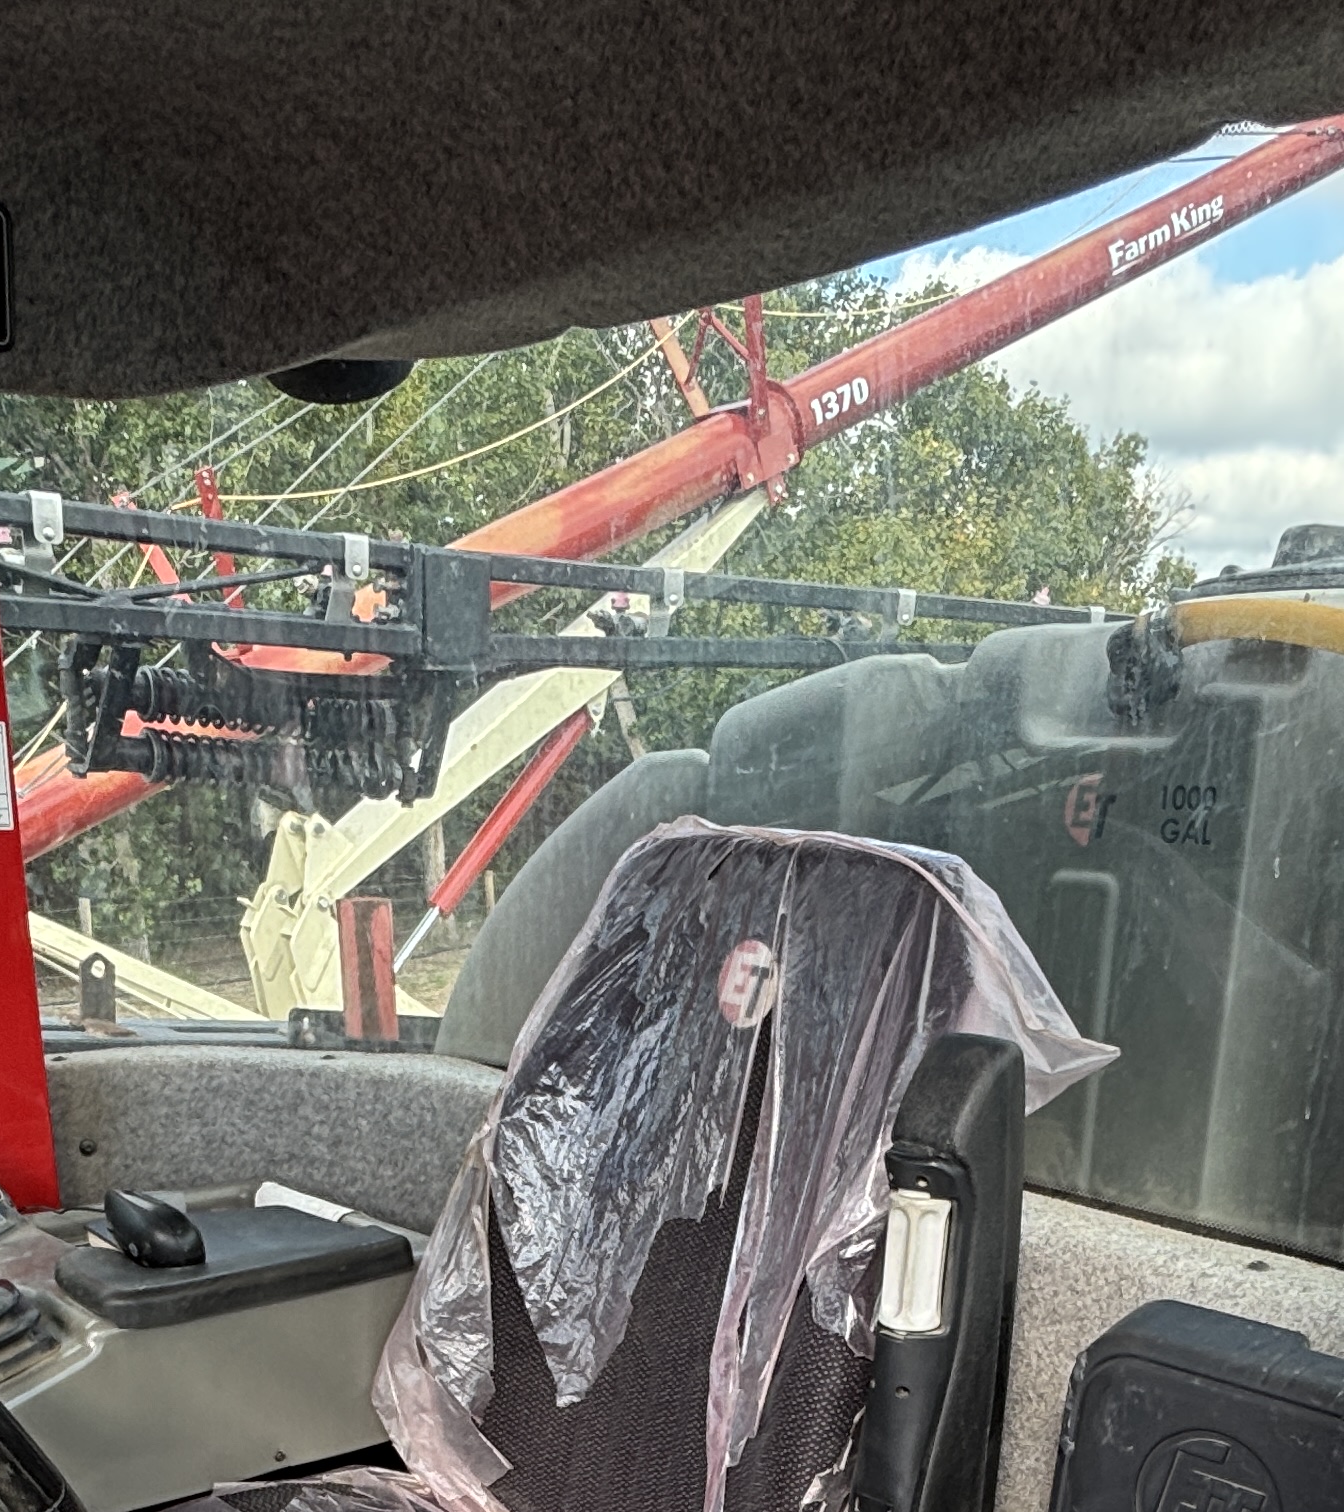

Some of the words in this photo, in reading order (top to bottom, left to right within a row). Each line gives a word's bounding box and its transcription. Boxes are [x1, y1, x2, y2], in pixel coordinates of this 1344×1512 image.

[1108, 224, 1171, 269] Farm
[1171, 195, 1224, 238] King
[810, 377, 869, 426] 1370
[1161, 784, 1217, 811] 1000
[1160, 818, 1211, 845] GAL
